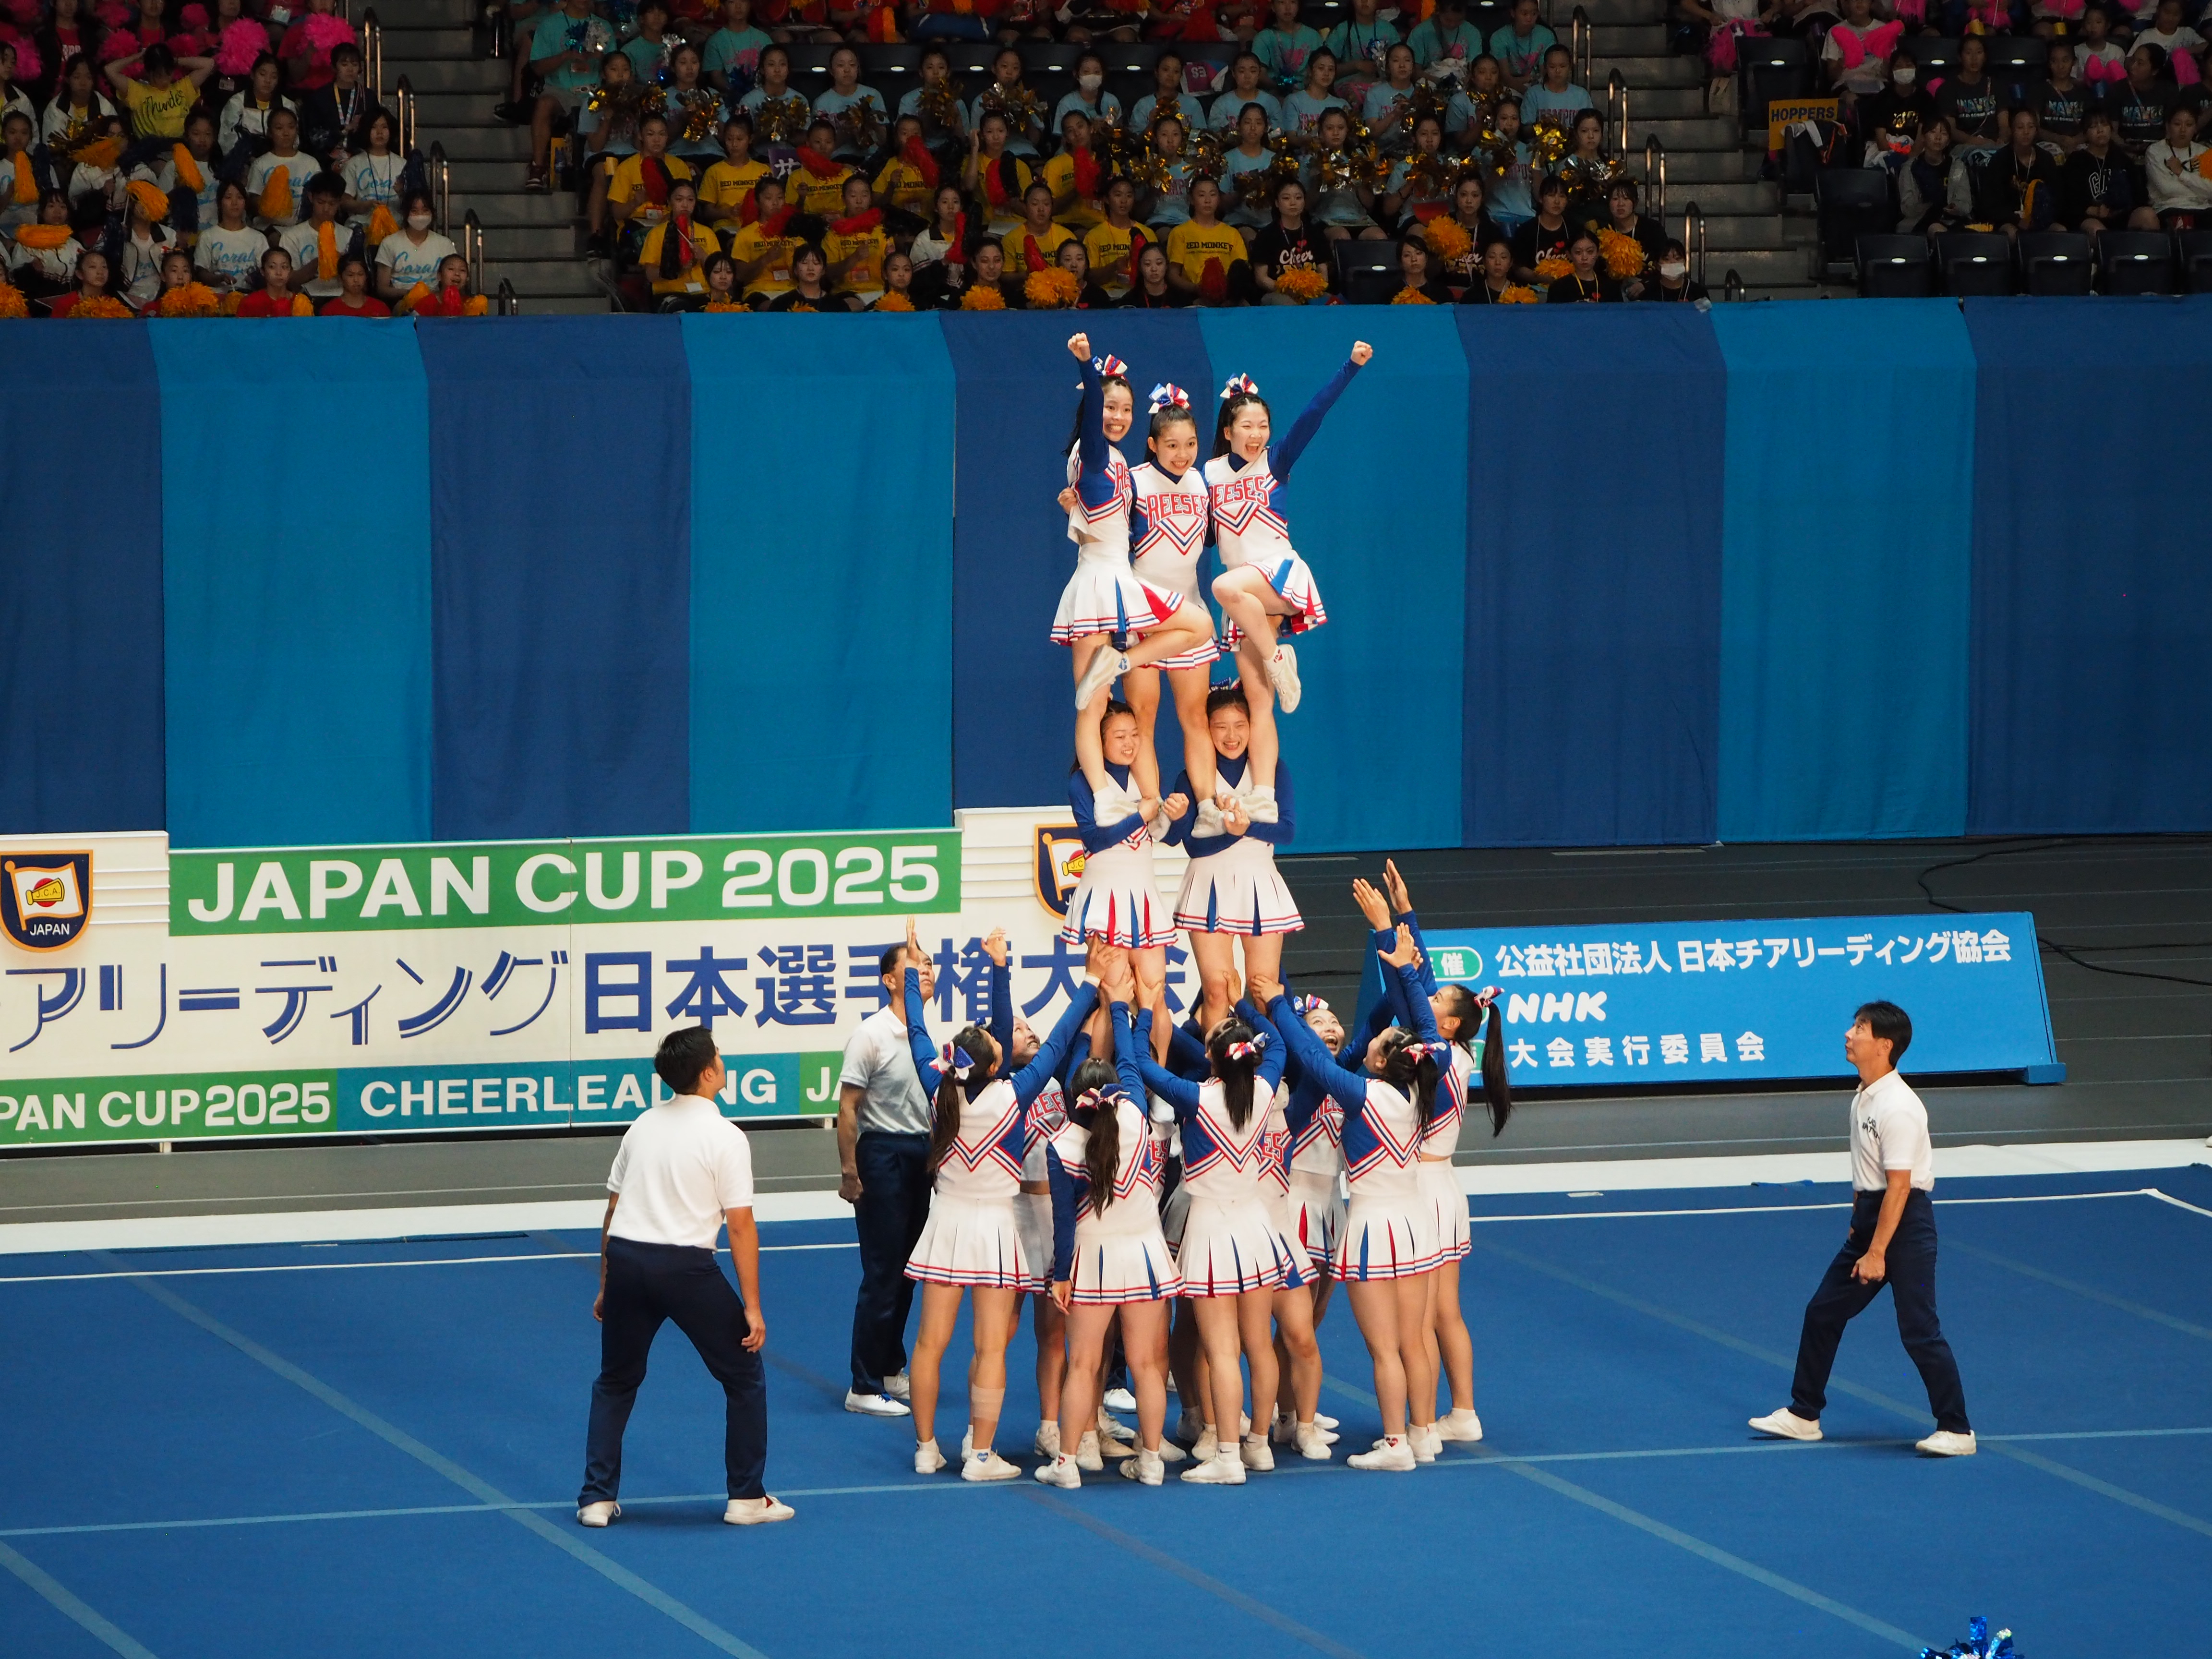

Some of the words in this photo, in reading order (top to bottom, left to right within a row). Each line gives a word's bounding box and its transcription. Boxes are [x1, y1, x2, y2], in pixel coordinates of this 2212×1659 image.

[1771, 107, 1835, 122] HOPPERS
[358, 168, 392, 190] Cora
[211, 241, 254, 265] Coral
[393, 252, 442, 273] Coral
[36, 888, 60, 898] J.C.A.
[188, 855, 489, 922] JAPAN
[515, 850, 703, 913] CUP
[722, 845, 939, 907] 2025
[30, 923, 69, 936] JAPAN
[1506, 990, 1608, 1024] NHK
[1508, 1031, 1765, 1069] 大会実行委員会
[360, 1069, 776, 1118] CHEERLEADNG
